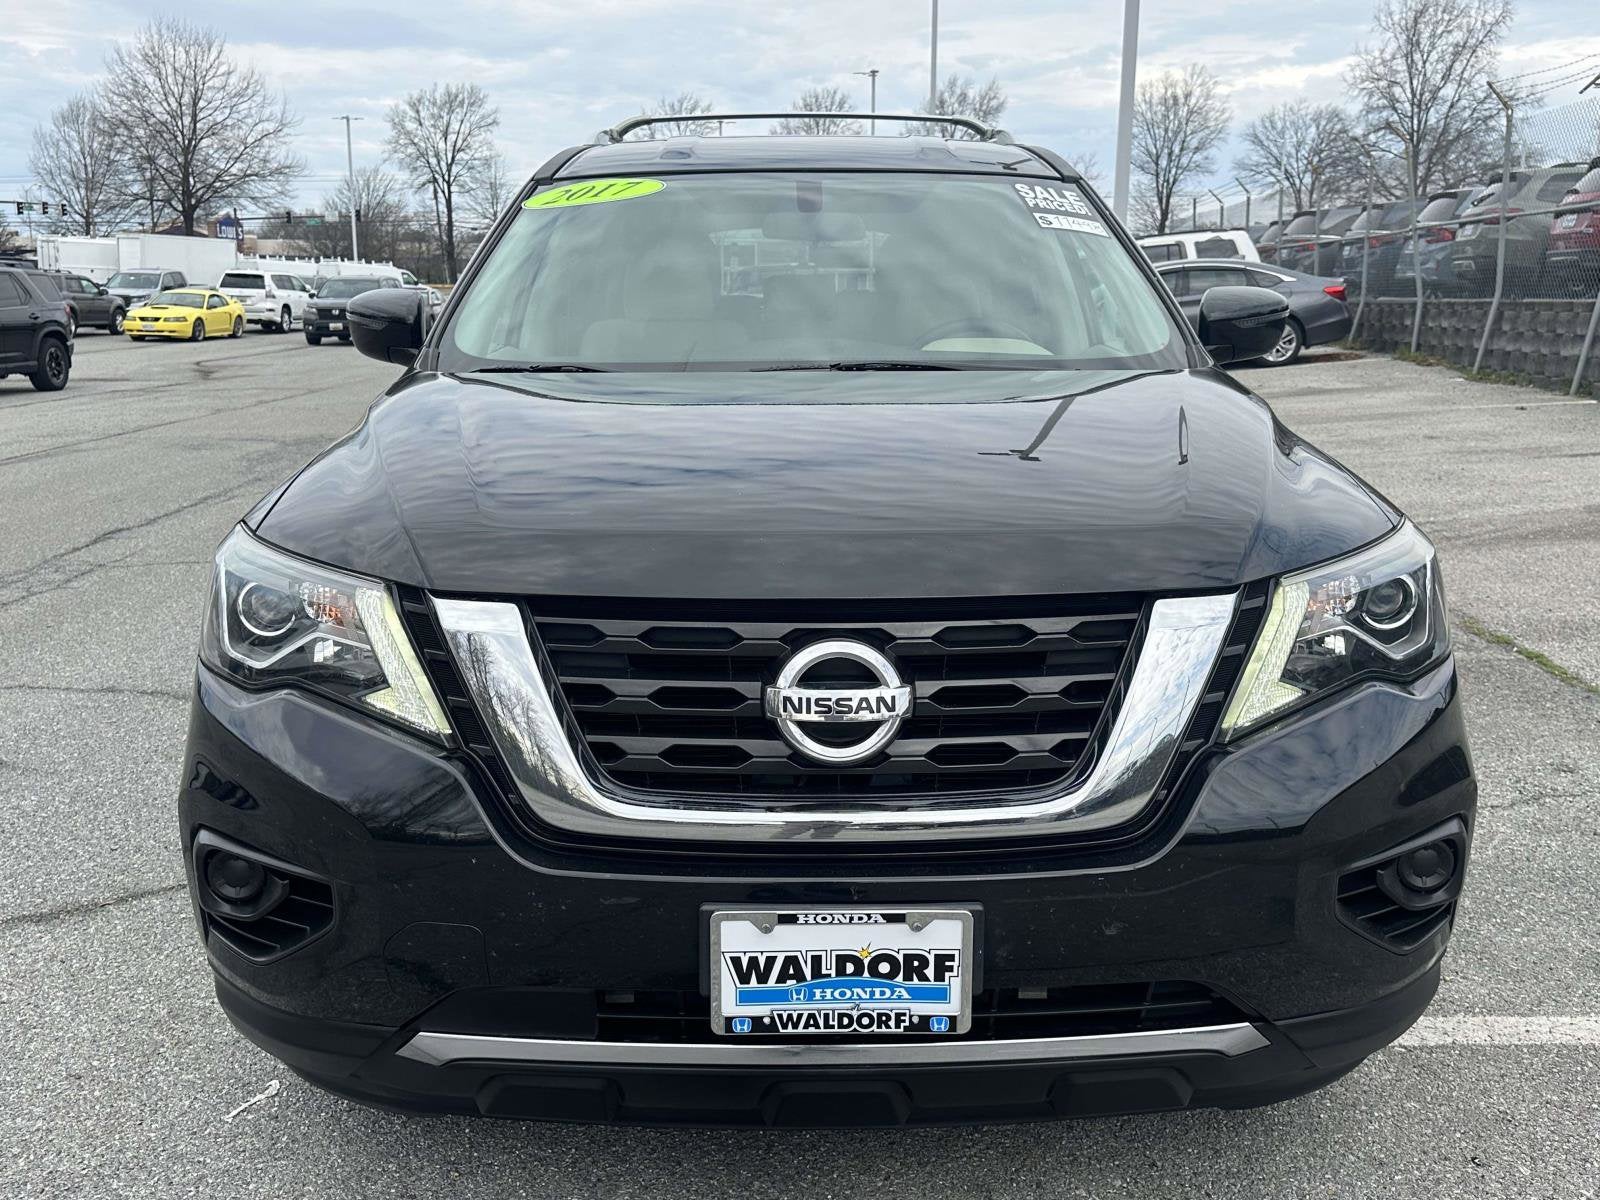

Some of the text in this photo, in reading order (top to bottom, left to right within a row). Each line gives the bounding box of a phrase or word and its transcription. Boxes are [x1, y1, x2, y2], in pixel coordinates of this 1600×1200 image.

[542, 181, 644, 206] 2017
[1014, 183, 1085, 206] SALE
[1024, 198, 1092, 216] PRICED!
[782, 695, 896, 715] NISSAN
[796, 913, 887, 924] HONDA
[727, 950, 959, 986] WALDORF
[812, 988, 912, 1000] HONDA
[774, 1010, 909, 1031] WALDORF
